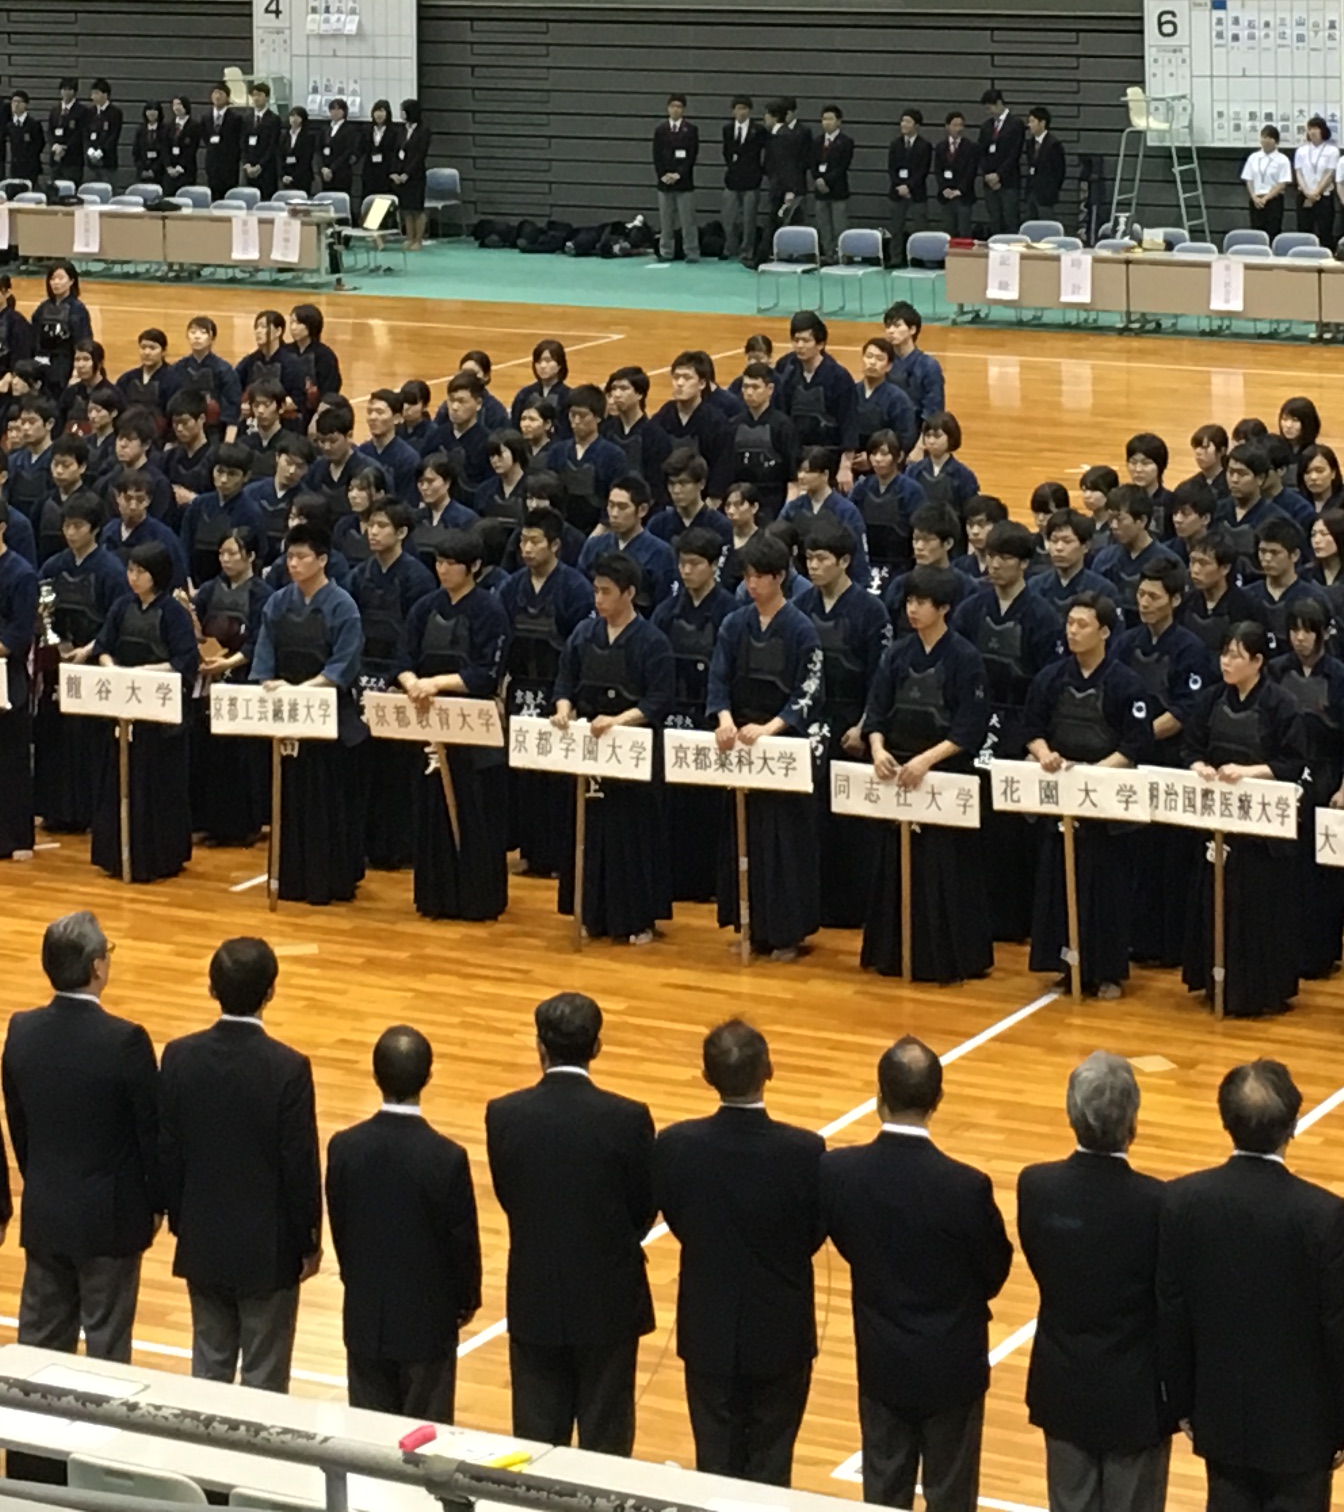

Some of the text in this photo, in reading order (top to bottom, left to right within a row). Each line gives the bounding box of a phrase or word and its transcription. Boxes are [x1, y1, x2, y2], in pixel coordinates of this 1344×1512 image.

[1157, 10, 1178, 38] 6
[66, 673, 173, 707] 龍谷大学
[211, 695, 332, 726] 京都工芸繊維大学
[372, 702, 496, 733] 京都教育大学
[512, 726, 648, 769] 京都学園大学
[671, 743, 798, 778] 京都薬科大学
[833, 773, 975, 816] 同志社大学
[999, 775, 1139, 813] 花園大学
